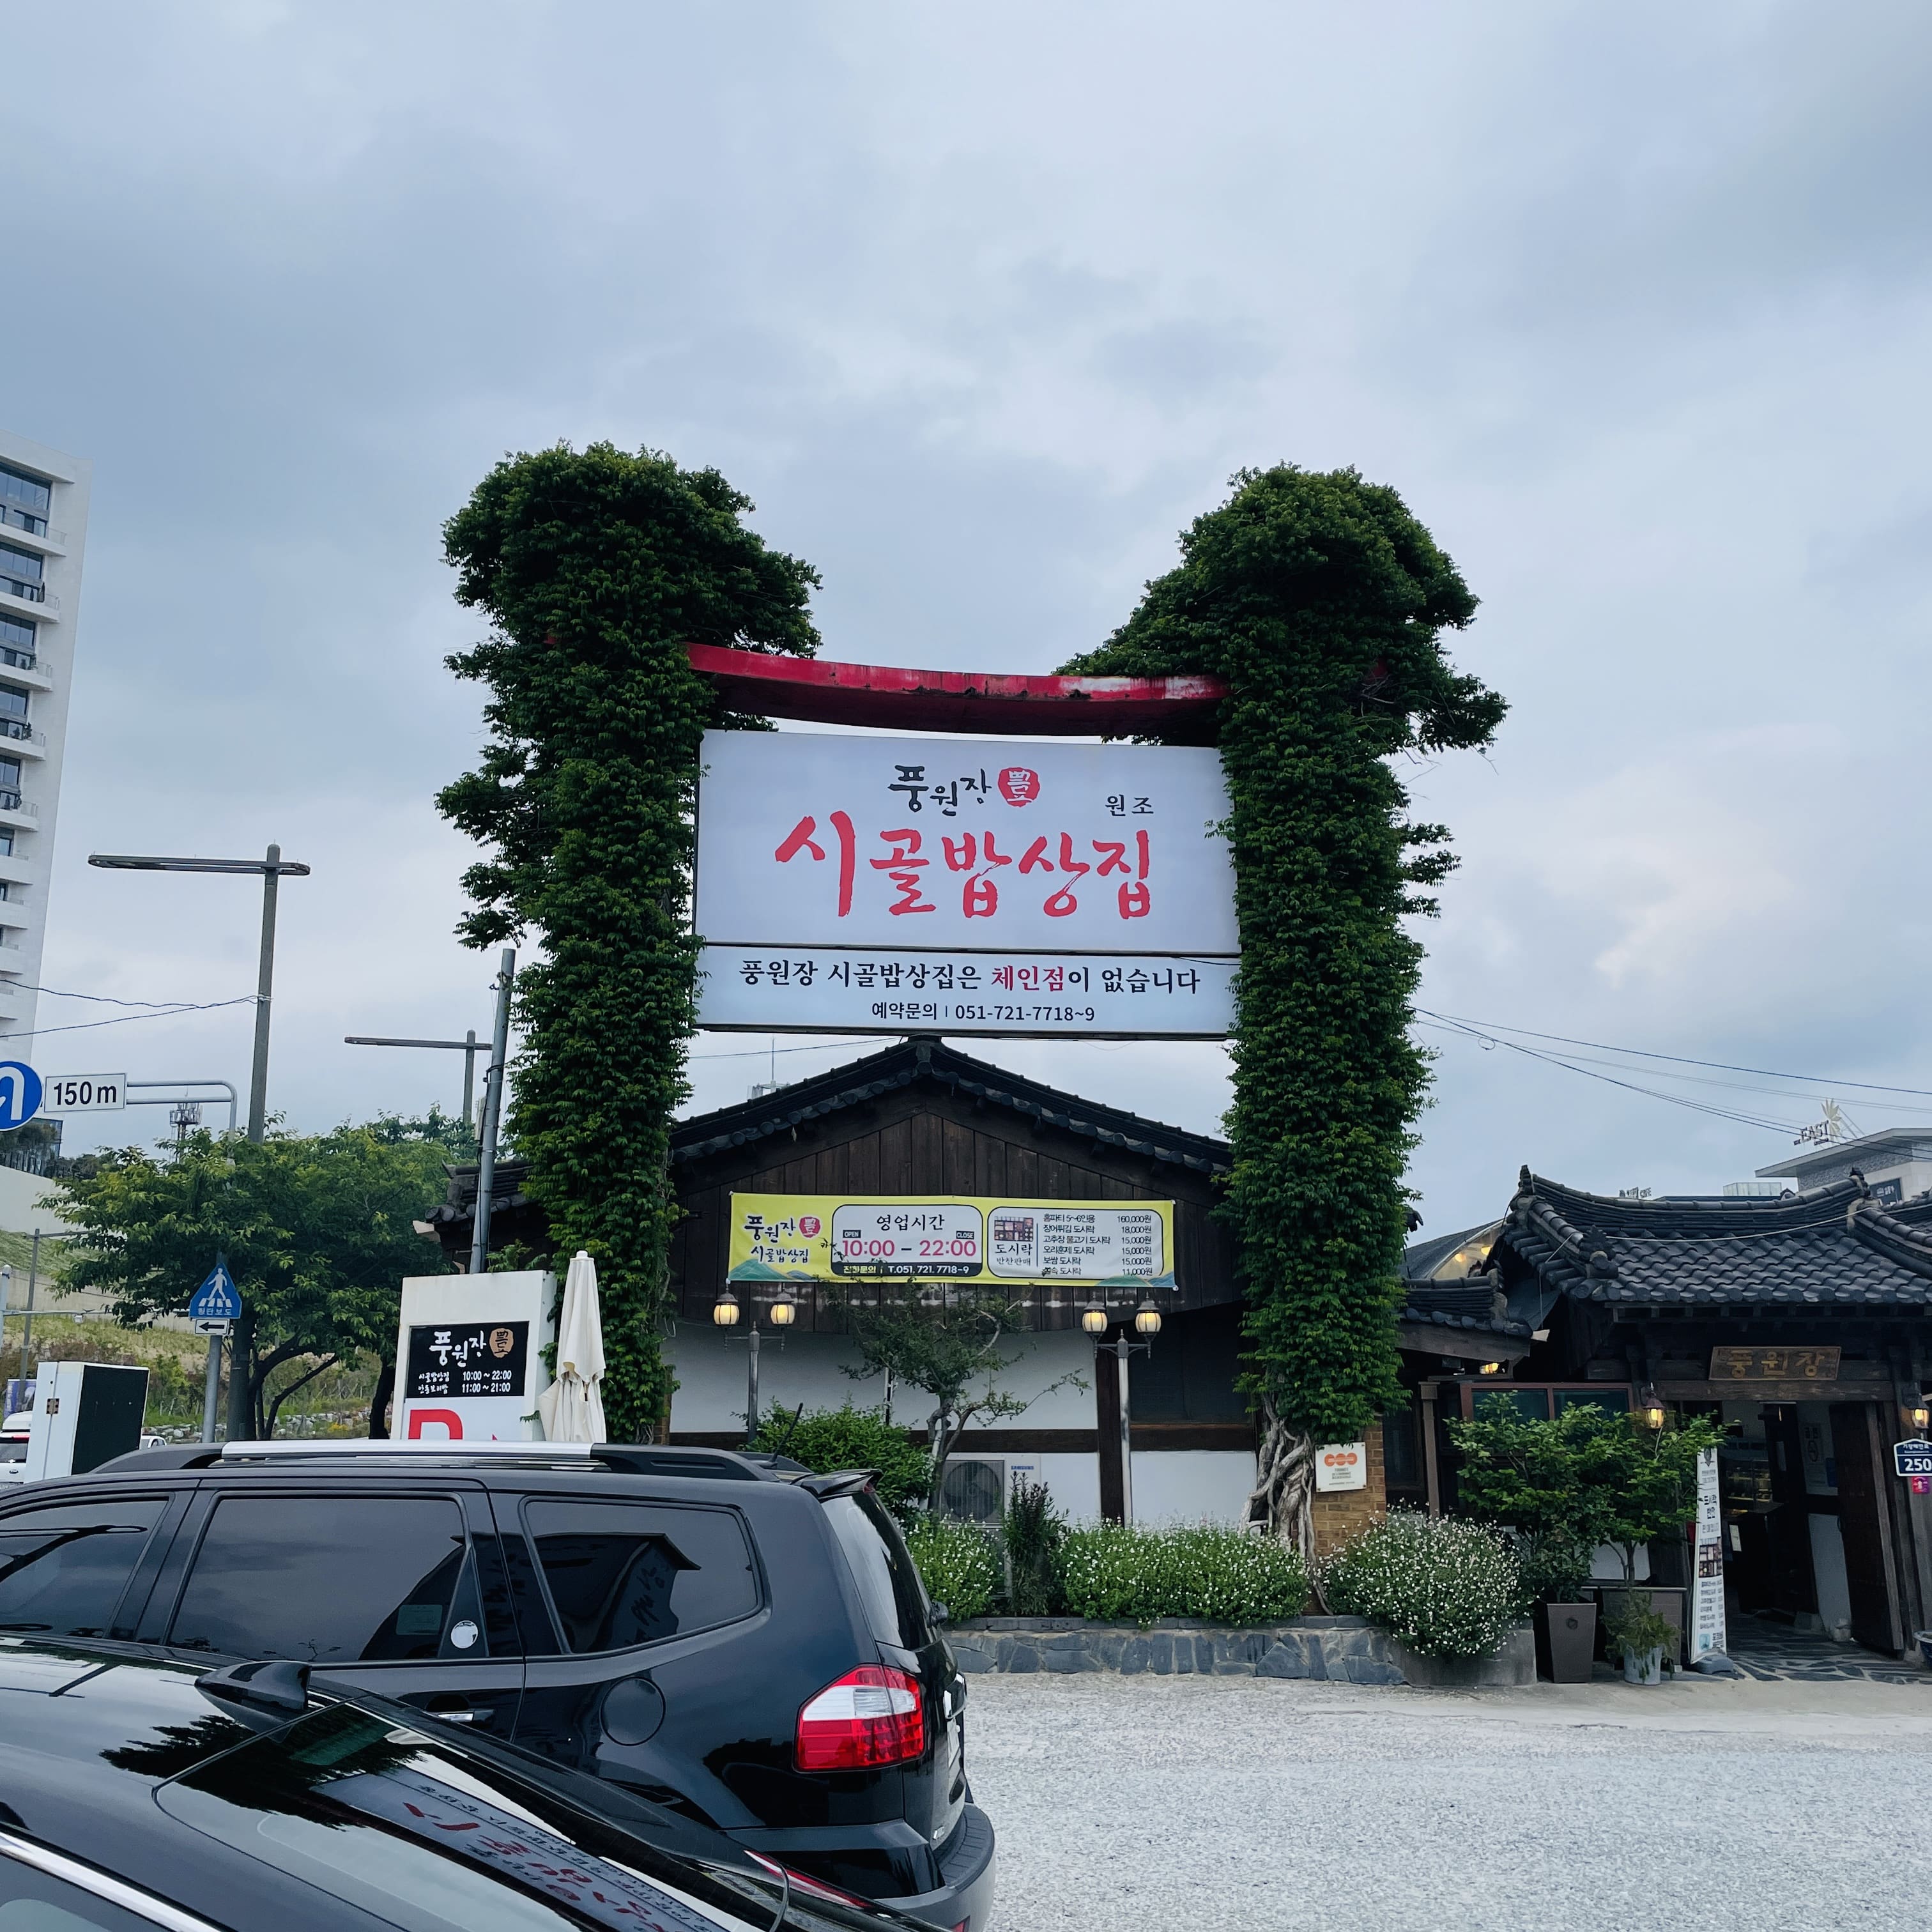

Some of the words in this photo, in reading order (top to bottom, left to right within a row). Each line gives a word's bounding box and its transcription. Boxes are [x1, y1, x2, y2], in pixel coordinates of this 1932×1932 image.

[889, 765, 992, 816] 풍원장
[1105, 794, 1154, 816] 원조
[774, 810, 1151, 919] 시골밥상집
[739, 960, 818, 987] 풍원장
[827, 961, 982, 991] 시골밥상집은
[992, 965, 1090, 993] 체인점이
[1101, 967, 1200, 995] 없습니다
[871, 1002, 937, 1020] 예약문의
[954, 1004, 1095, 1023] 051-721-7718~9
[877, 1214, 945, 1231] 영업시간
[1043, 1214, 1064, 1222] 홈파티
[1066, 1215, 1096, 1223] 5~6인용
[1117, 1215, 1151, 1223] 160,000원
[744, 1216, 796, 1243] 풍원장
[1043, 1224, 1071, 1233] 장어튀김
[1073, 1225, 1095, 1234] 도시락
[1121, 1225, 1152, 1234] 18,000원
[1043, 1235, 1064, 1243] 고추장
[1089, 1236, 1110, 1245] 도시락
[1121, 1236, 1152, 1245] 15,000원
[751, 1245, 809, 1264] 시골밥상집
[842, 1239, 895, 1257] 10:00
[919, 1239, 976, 1257] 22:00
[995, 1243, 1032, 1256] 도시락
[1043, 1245, 1072, 1254] 오리훈제
[1073, 1246, 1095, 1255] 도시락
[1122, 1246, 1152, 1255] 15,000원
[997, 1256, 1031, 1266] 반찬판매
[1043, 1256, 1058, 1264] 보쌈
[1059, 1257, 1081, 1265] 도시락
[1122, 1257, 1152, 1266] 15,000원
[1060, 1267, 1082, 1275] 도시락
[1123, 1268, 1153, 1276] 11,000원
[429, 1331, 487, 1367] 풍원장
[1726, 1350, 1825, 1379] 풍원장
[418, 1371, 450, 1383] 시골밥상집
[463, 1370, 482, 1381] 10:00
[491, 1370, 512, 1381] 22:00
[462, 1383, 481, 1393] 11:00
[490, 1382, 511, 1393] 21:00
[1905, 1458, 1932, 1471] 250
